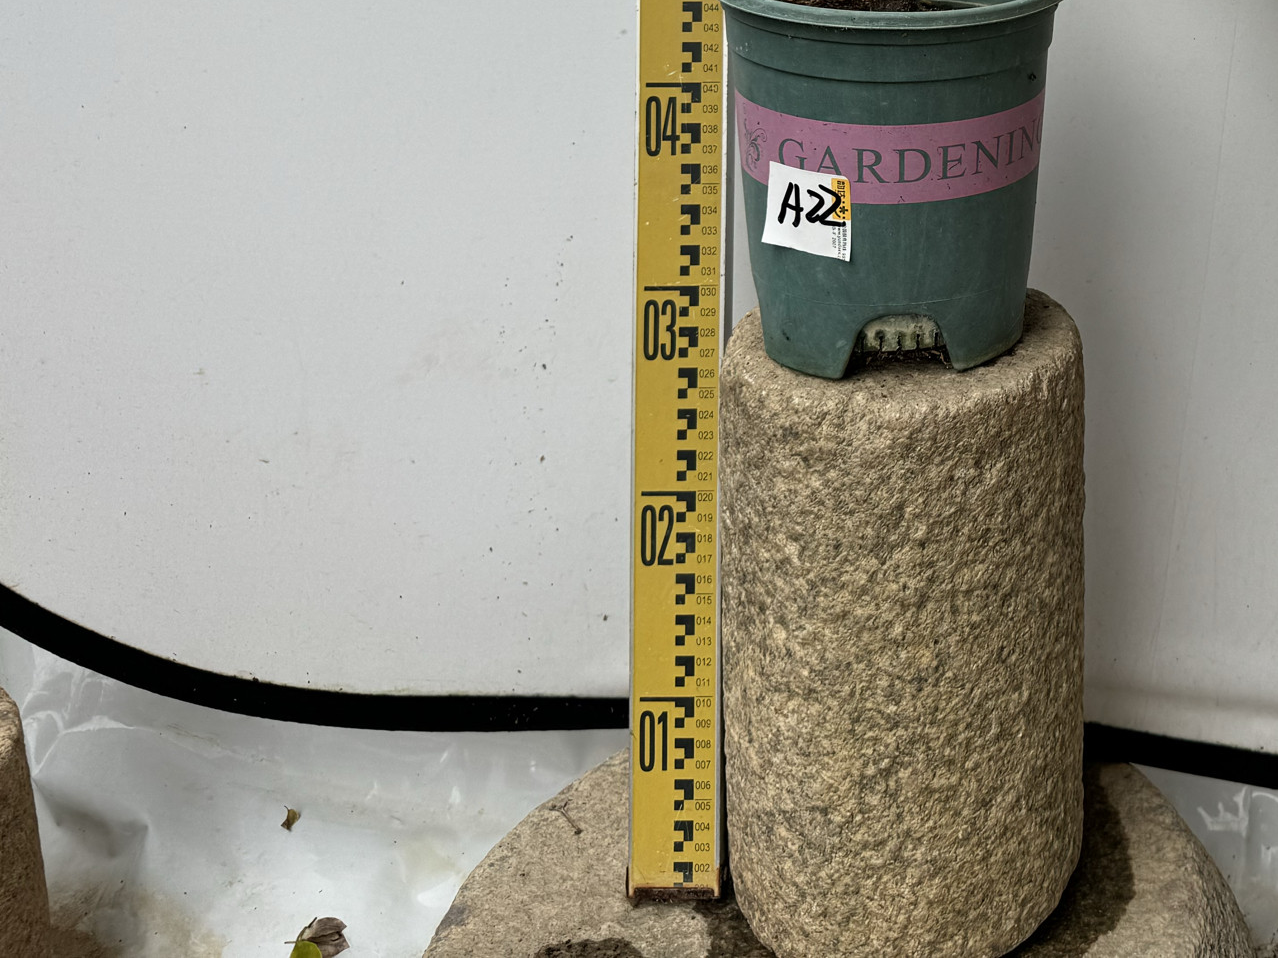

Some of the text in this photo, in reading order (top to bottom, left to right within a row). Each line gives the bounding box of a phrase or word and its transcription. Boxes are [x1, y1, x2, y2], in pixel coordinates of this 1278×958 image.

[703, 3, 719, 12] 044
[703, 23, 719, 32] 043
[703, 43, 719, 52] 042
[703, 64, 719, 73] 041
[703, 84, 719, 93] 040
[702, 104, 719, 113] 039
[645, 96, 680, 157] 04
[702, 125, 719, 134] 038
[702, 145, 719, 154] 037
[702, 165, 718, 174] 036
[702, 186, 718, 195] 035
[777, 181, 847, 228] A22
[702, 206, 718, 215] 034
[701, 226, 718, 235] 033
[701, 246, 717, 255] 032
[701, 267, 717, 276] 031
[701, 288, 716, 297] 030
[700, 308, 716, 317] 029
[643, 299, 677, 361] 03
[700, 328, 716, 337] 028
[699, 348, 716, 357] 027
[699, 369, 715, 378] 026
[699, 390, 715, 399] 025
[698, 410, 715, 419] 024
[698, 431, 714, 440] 023
[698, 451, 714, 460] 022
[697, 472, 714, 481] 021
[697, 493, 713, 502] 020
[697, 513, 713, 522] 019
[641, 504, 674, 566] 02
[697, 534, 713, 543] 018
[696, 554, 713, 563] 017
[696, 575, 712, 584] 016
[696, 596, 712, 605] 015
[696, 616, 712, 625] 014
[696, 637, 712, 646] 013
[696, 657, 712, 666] 012
[696, 678, 712, 687] 011
[696, 699, 712, 708] 010
[695, 719, 712, 728] 009
[639, 710, 668, 772] 01
[695, 740, 711, 749] 008
[695, 760, 711, 769] 007
[695, 781, 711, 790] 006
[695, 802, 711, 811] 005
[694, 822, 711, 831] 004
[694, 843, 710, 852] 003
[694, 863, 710, 872] 002
